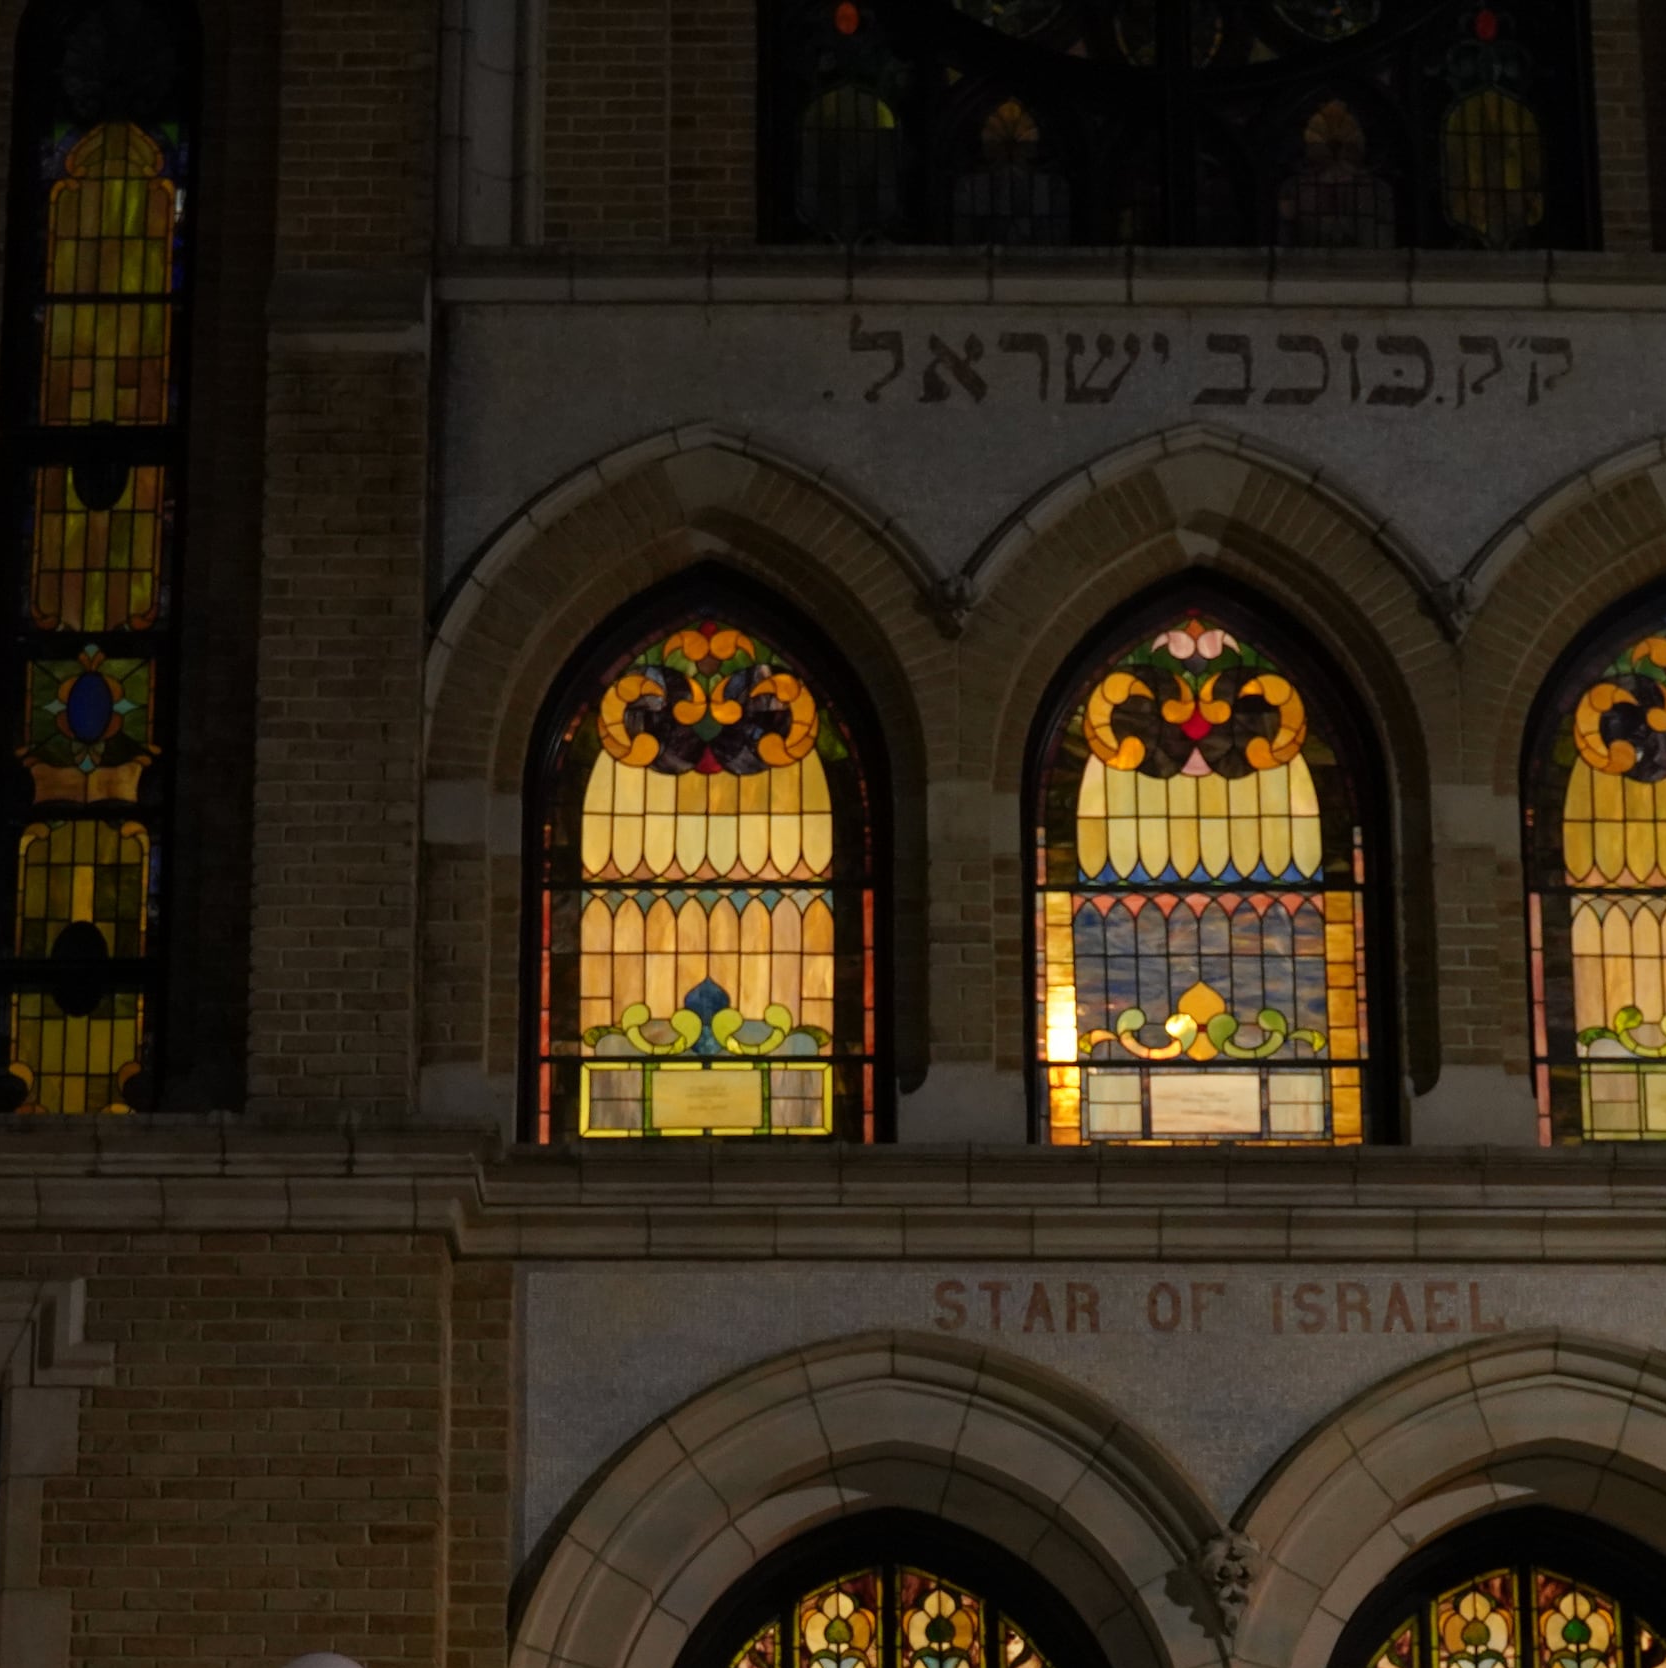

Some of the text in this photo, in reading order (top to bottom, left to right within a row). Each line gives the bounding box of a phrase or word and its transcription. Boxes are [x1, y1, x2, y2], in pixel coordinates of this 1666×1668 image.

[935, 1280, 1506, 1335] STAR OF ISRAEL
